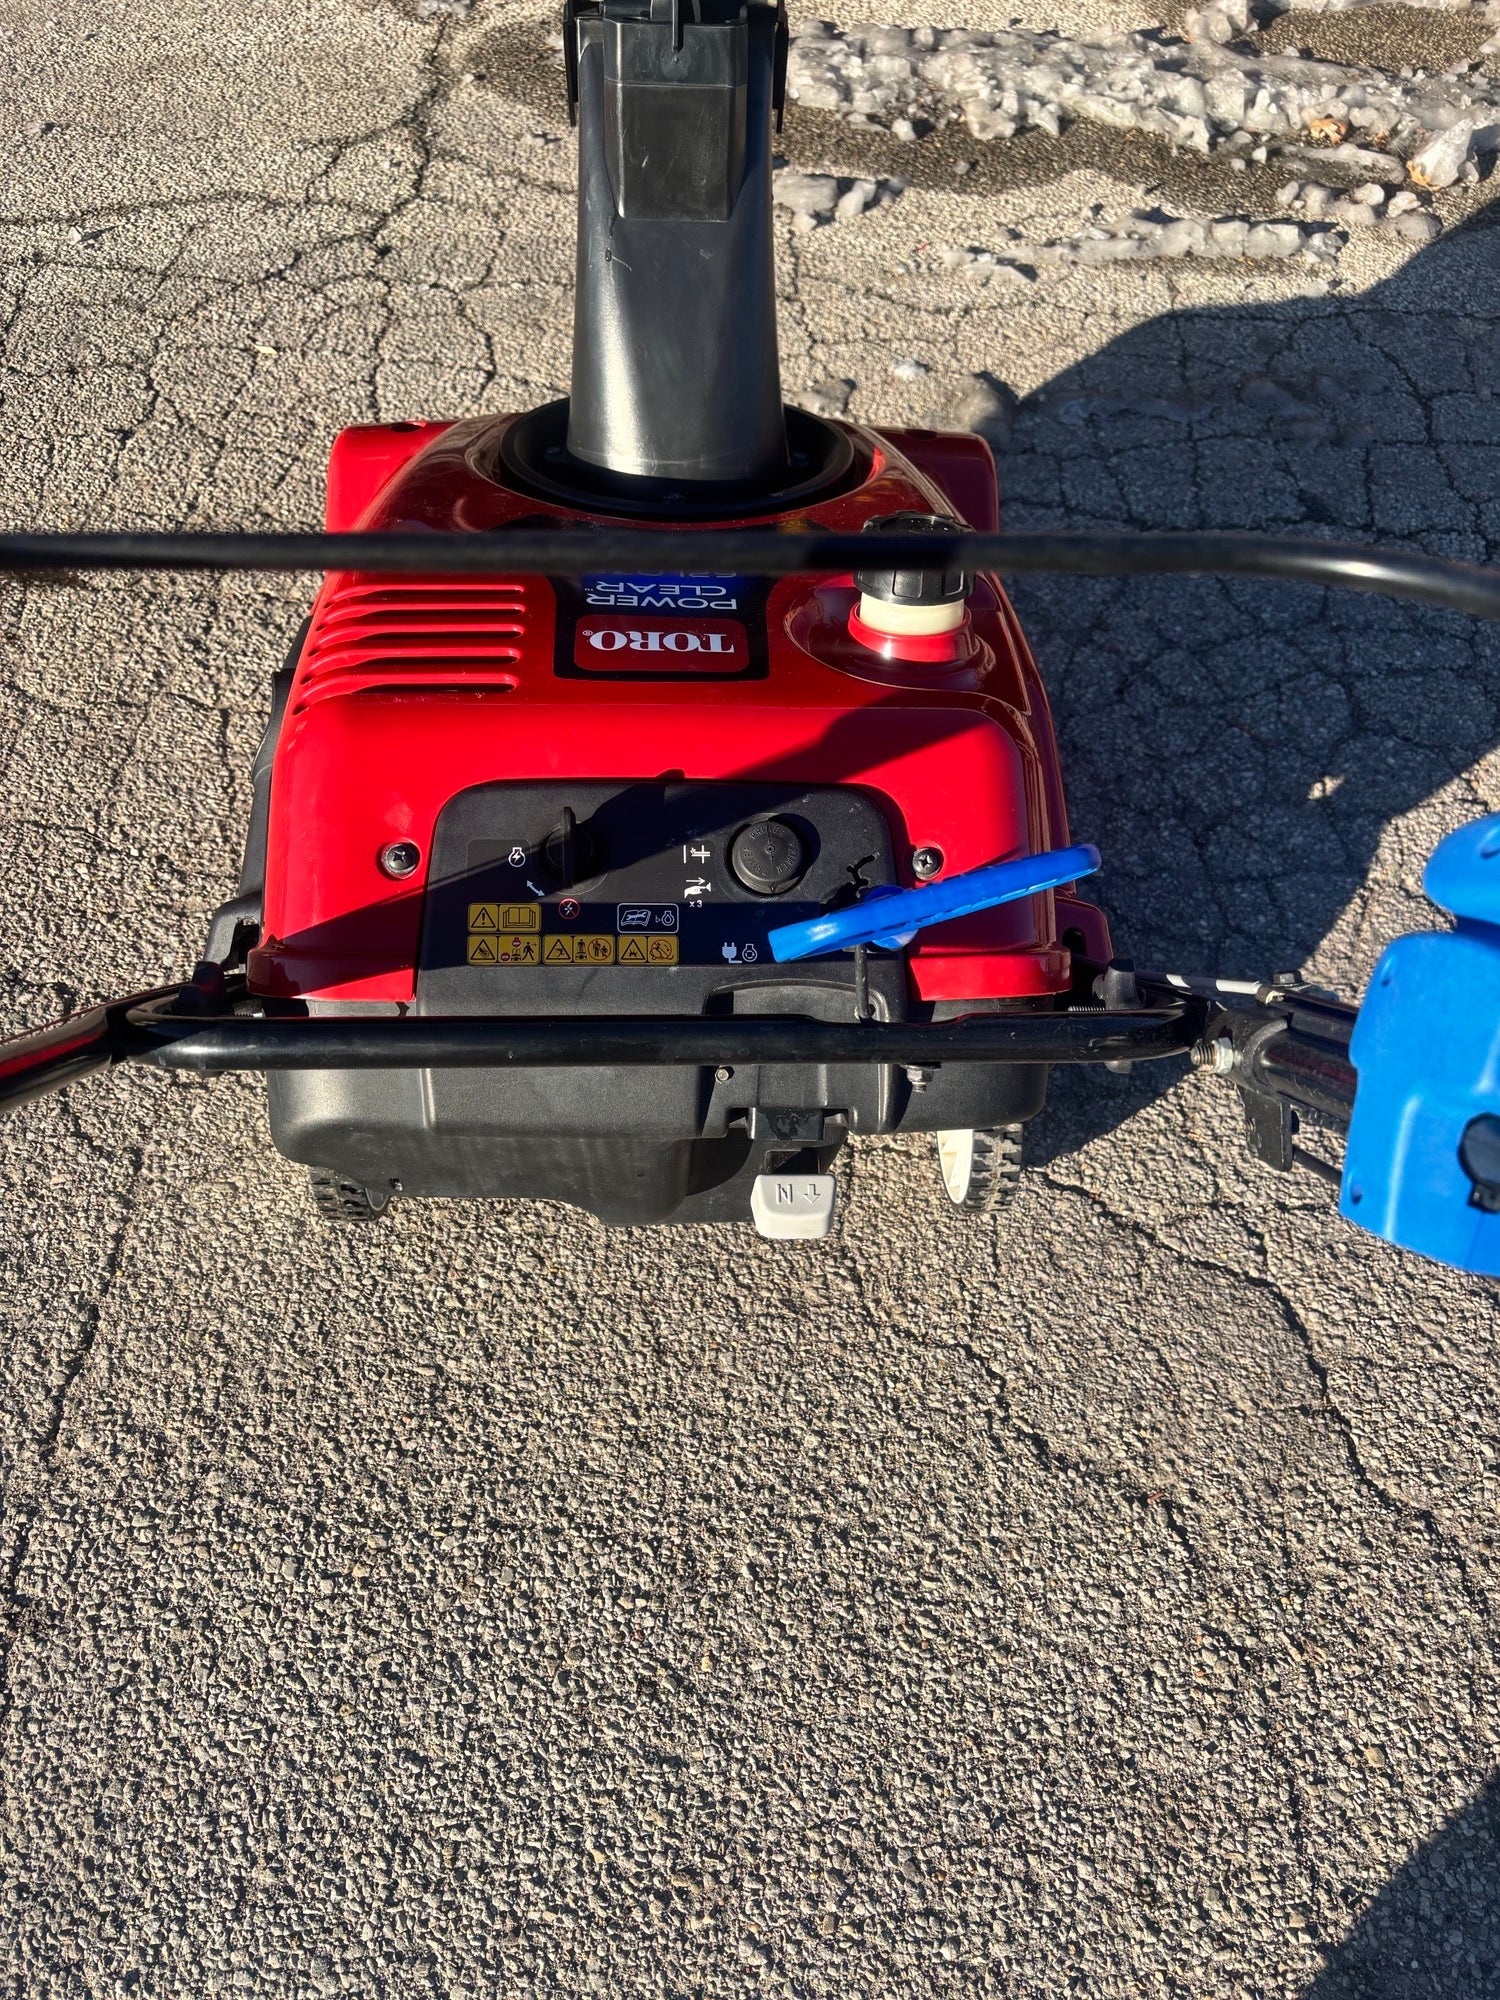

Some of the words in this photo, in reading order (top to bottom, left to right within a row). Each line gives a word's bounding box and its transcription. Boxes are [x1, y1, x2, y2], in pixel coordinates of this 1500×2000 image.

[586, 593, 738, 610] POWER
[697, 900, 703, 908] 3
[775, 1183, 793, 1205] N
